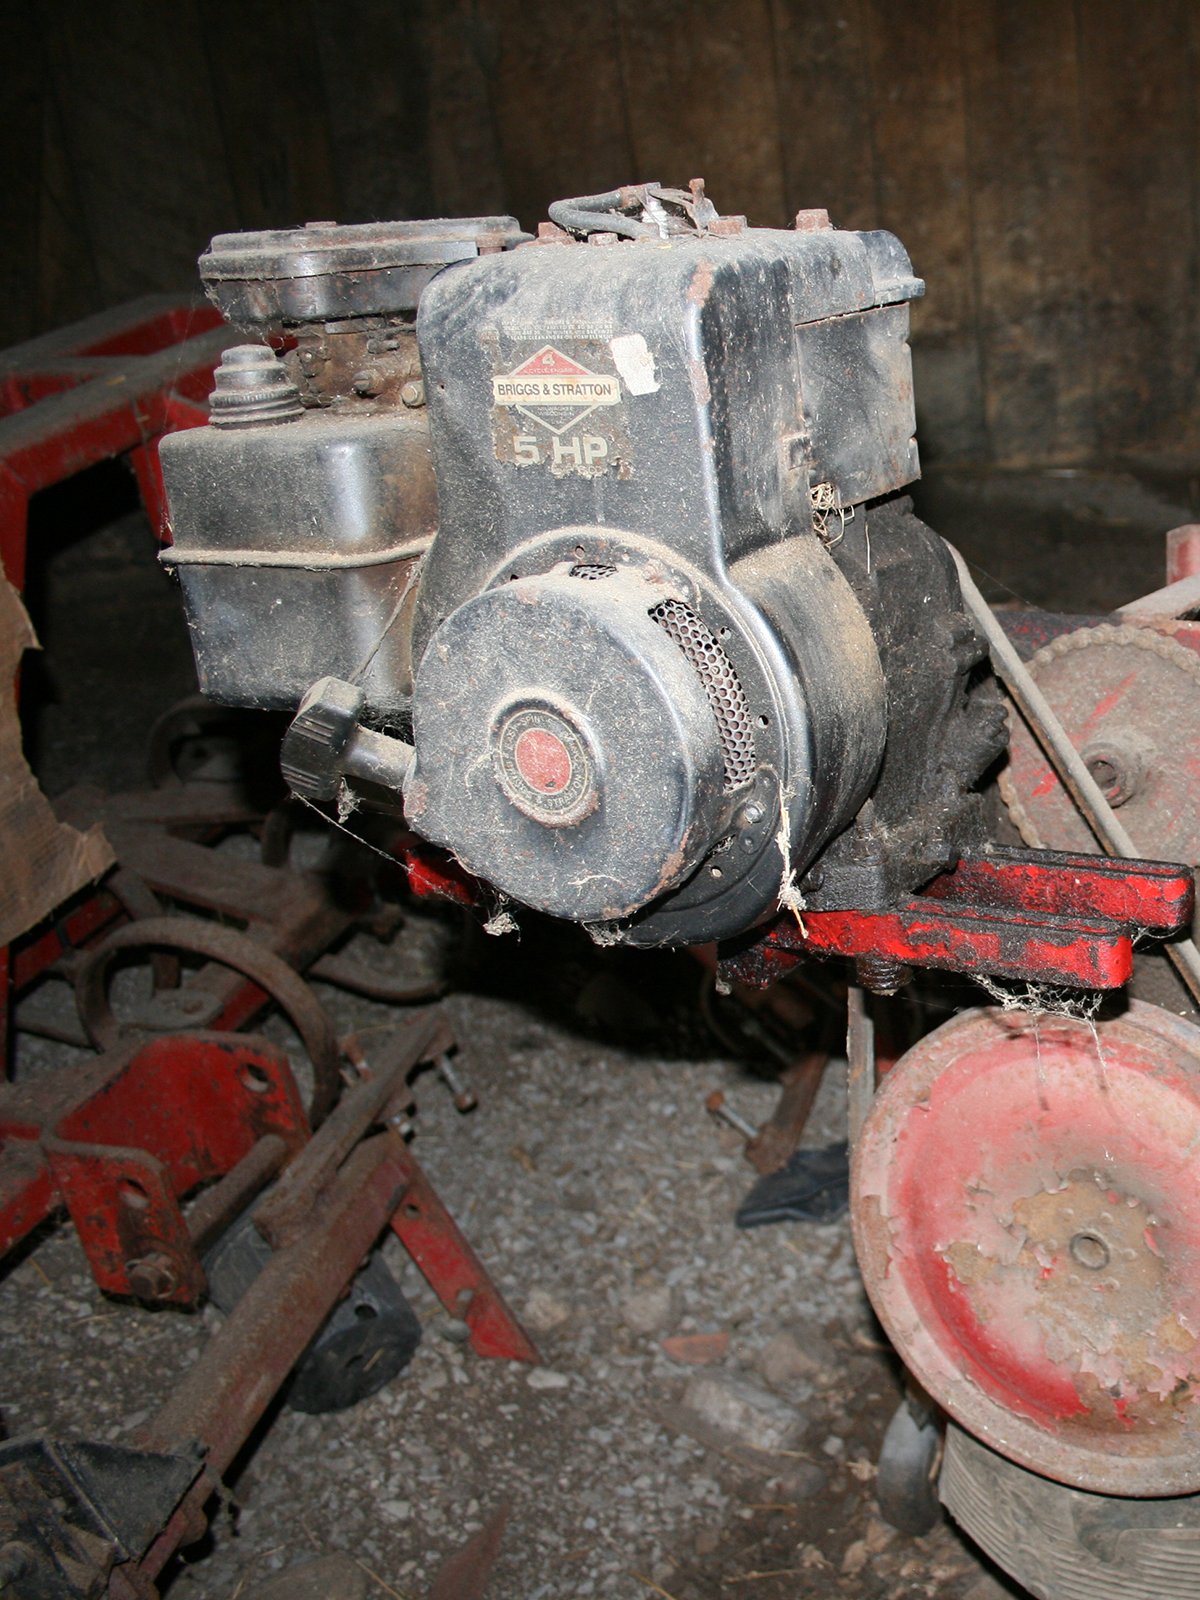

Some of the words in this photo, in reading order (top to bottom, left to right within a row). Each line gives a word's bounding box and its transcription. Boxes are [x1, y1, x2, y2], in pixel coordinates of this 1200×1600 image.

[498, 383, 540, 397] BRIGGS
[543, 383, 552, 396] &
[552, 383, 612, 396] STRATTON
[513, 435, 541, 465] 5
[552, 436, 610, 466] HP
